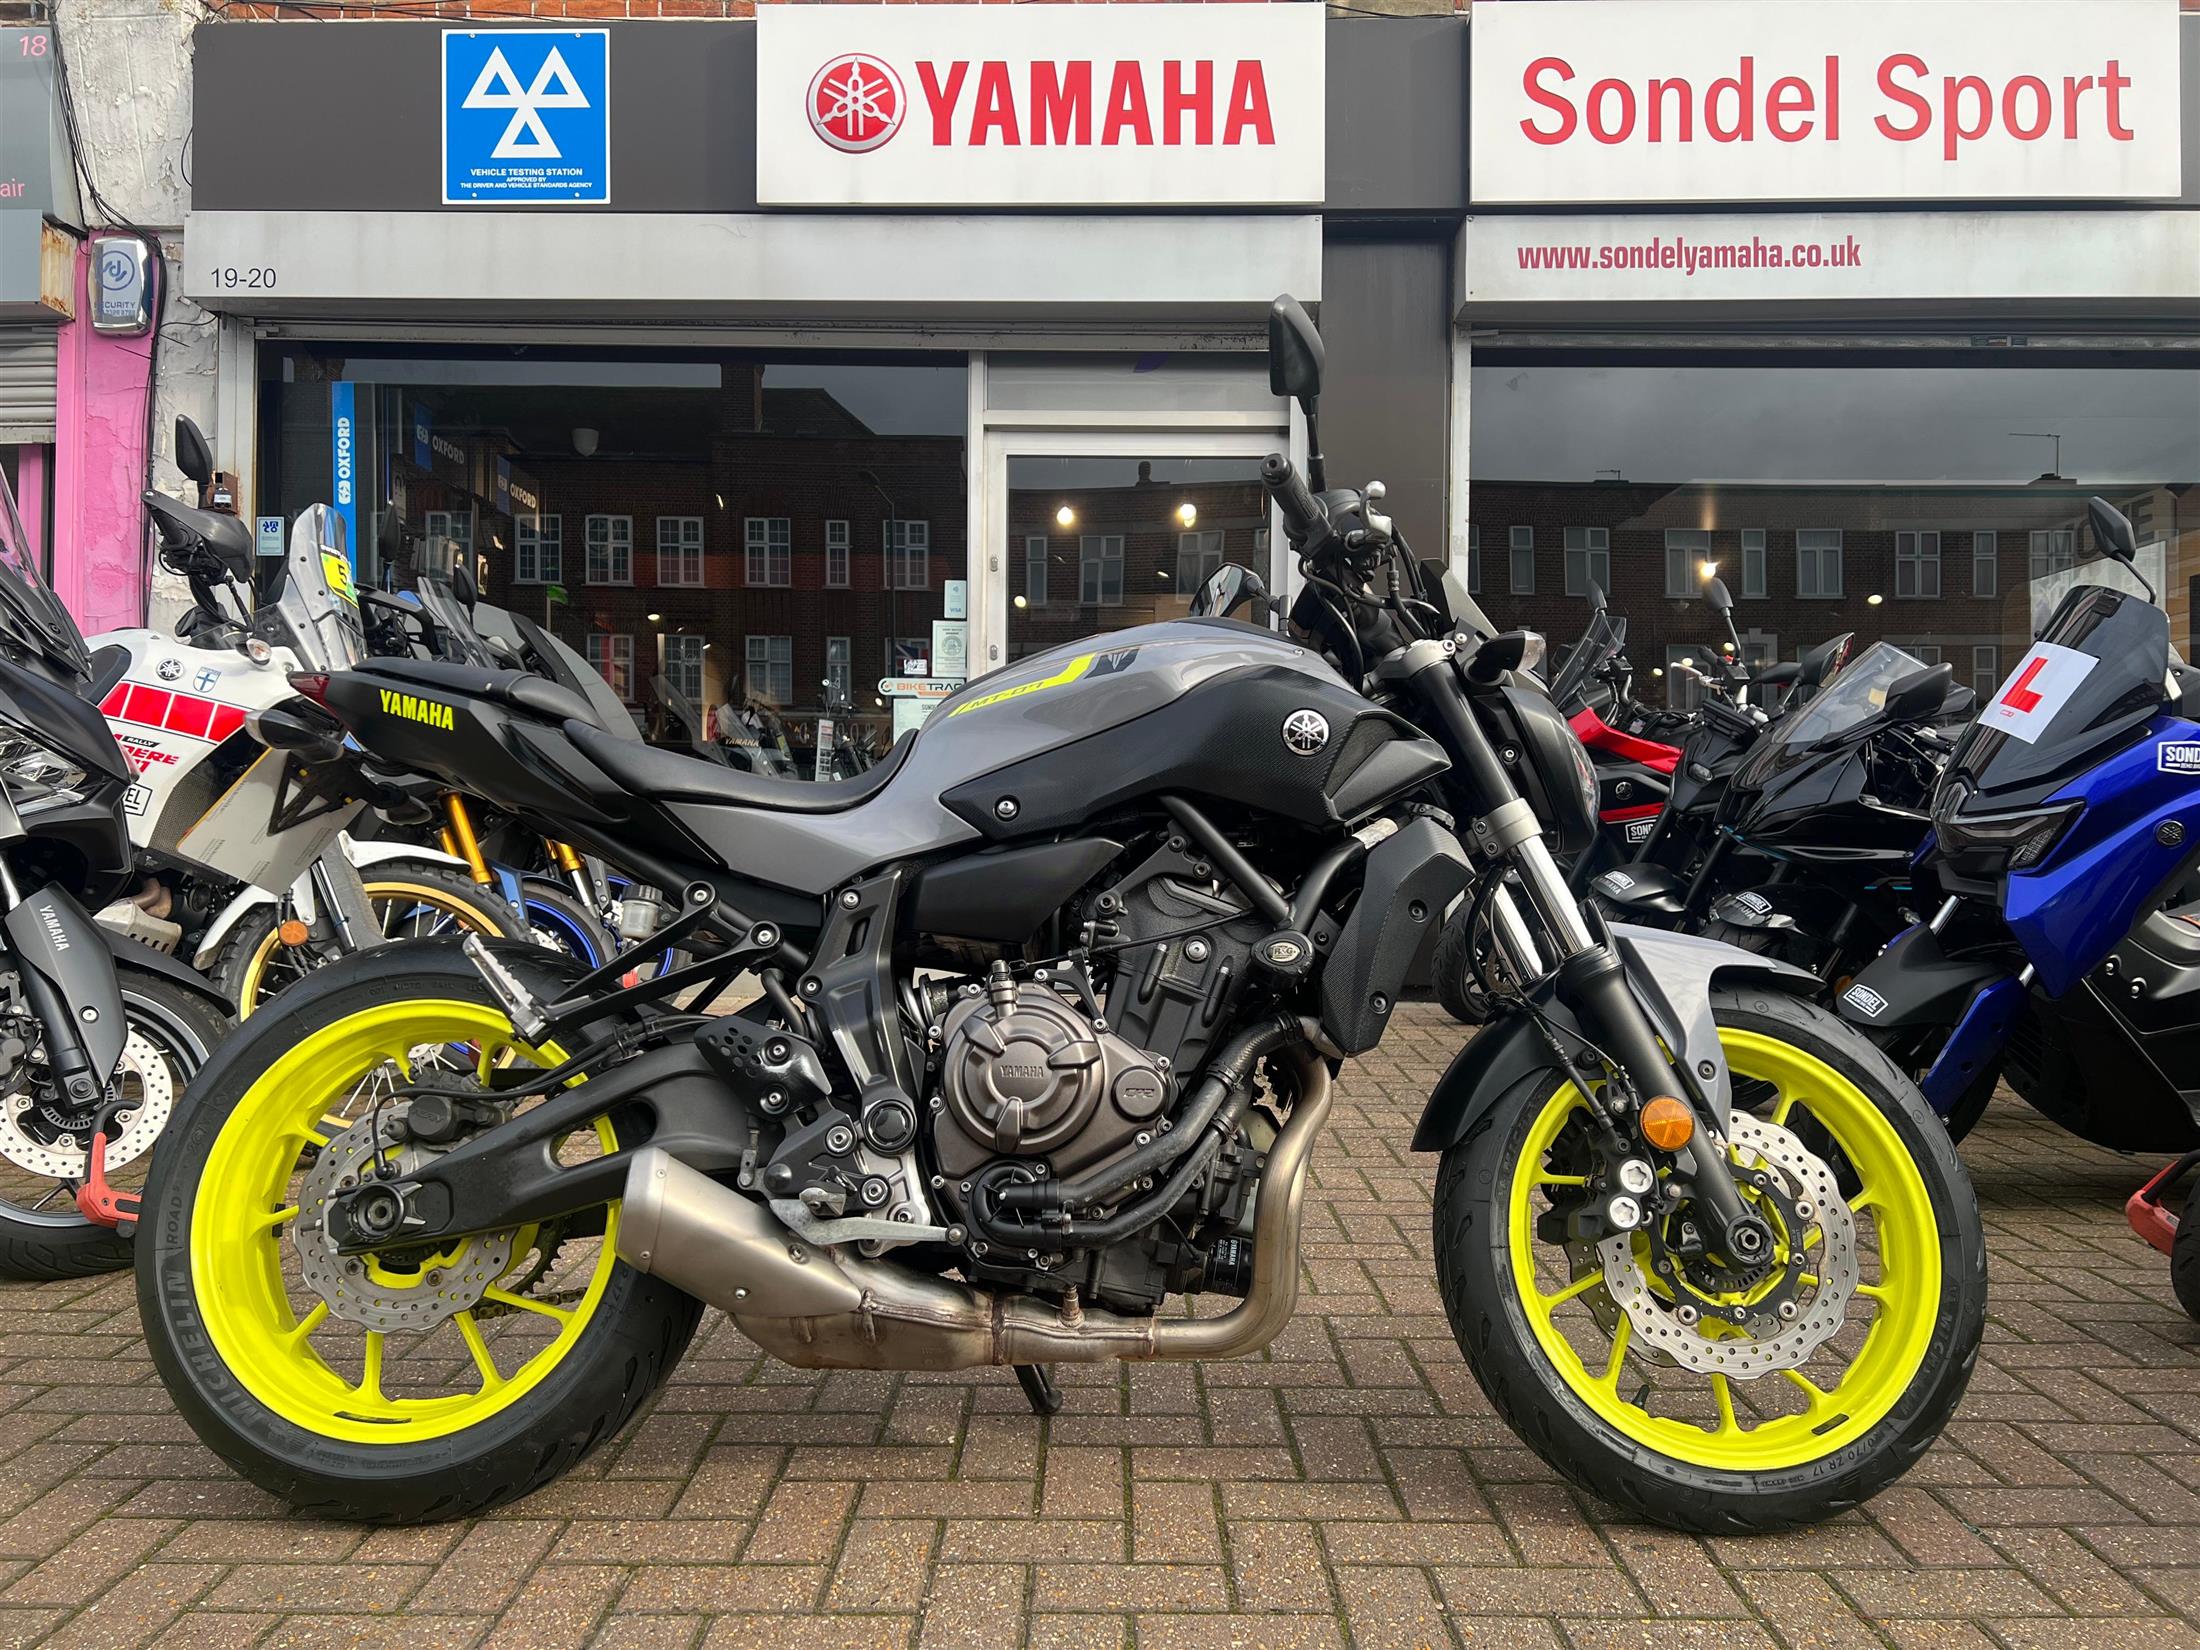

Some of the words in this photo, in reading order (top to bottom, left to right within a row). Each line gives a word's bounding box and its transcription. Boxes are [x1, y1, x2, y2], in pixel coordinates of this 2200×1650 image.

[19, 35, 48, 57] 18
[915, 60, 1276, 146] YAMAHA
[1519, 56, 1840, 146] Sondel
[1873, 53, 2134, 161] Sport
[470, 168, 507, 176] VEHICLE
[508, 168, 545, 176] TESTING
[546, 168, 583, 176] STATION
[1517, 235, 1862, 275] www.sondelyamaha.co.uk
[210, 266, 277, 289] 19-20
[337, 416, 351, 479] OXFORD
[431, 435, 466, 465] OXFORD
[509, 485, 538, 509] OXFORD
[970, 681, 1045, 710] MT-07
[2000, 657, 2049, 713] L
[380, 688, 454, 731] YAMAHA
[126, 737, 156, 748] RALLY
[40, 904, 71, 952] YAMAHA
[1851, 987, 1881, 1010] SONDEL
[1001, 1065, 1044, 1078] YAMAHA
[166, 1199, 182, 1244] ROAD
[1229, 1244, 1238, 1265] YAMAHA
[167, 1270, 264, 1427] MICHELIN
